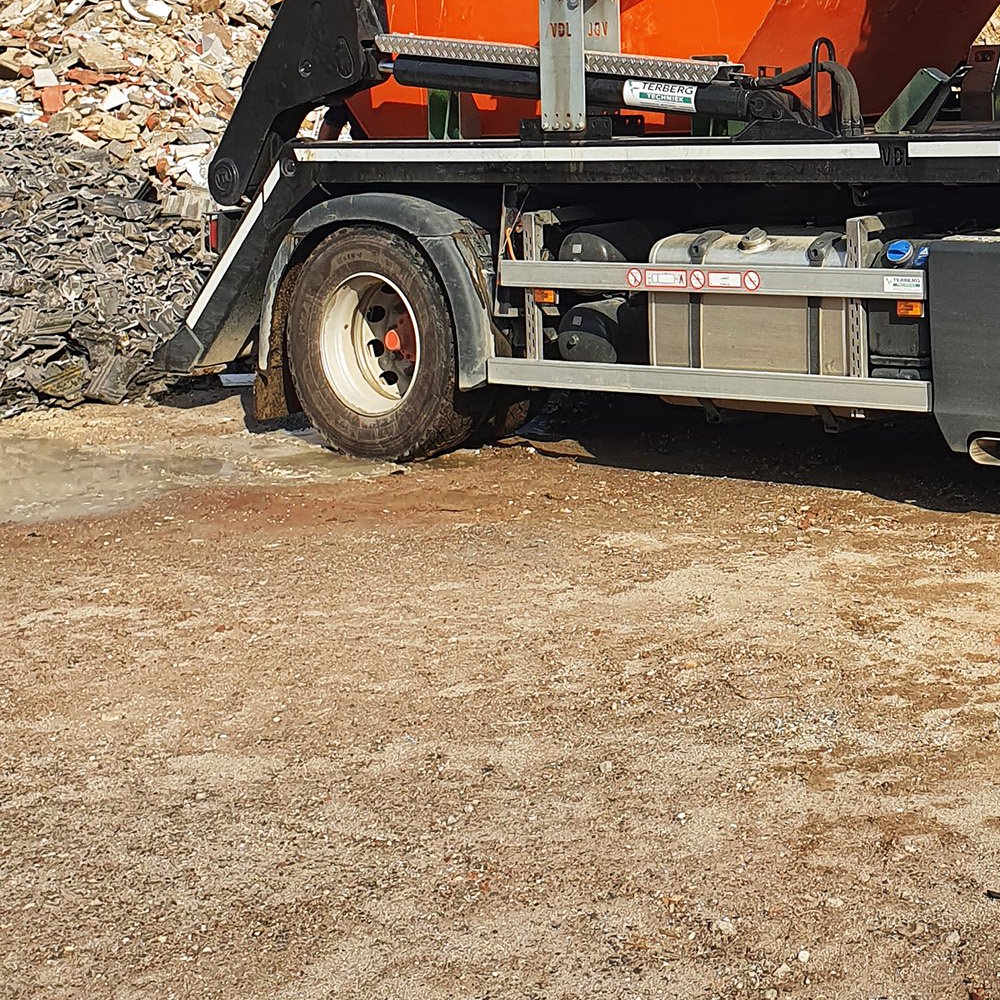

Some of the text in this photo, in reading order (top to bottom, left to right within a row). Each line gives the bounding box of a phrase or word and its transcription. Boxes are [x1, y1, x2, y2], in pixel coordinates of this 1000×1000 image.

[549, 21, 572, 38] VDL
[642, 82, 694, 95] TERBERG
[647, 93, 684, 103] TECHNIEK
